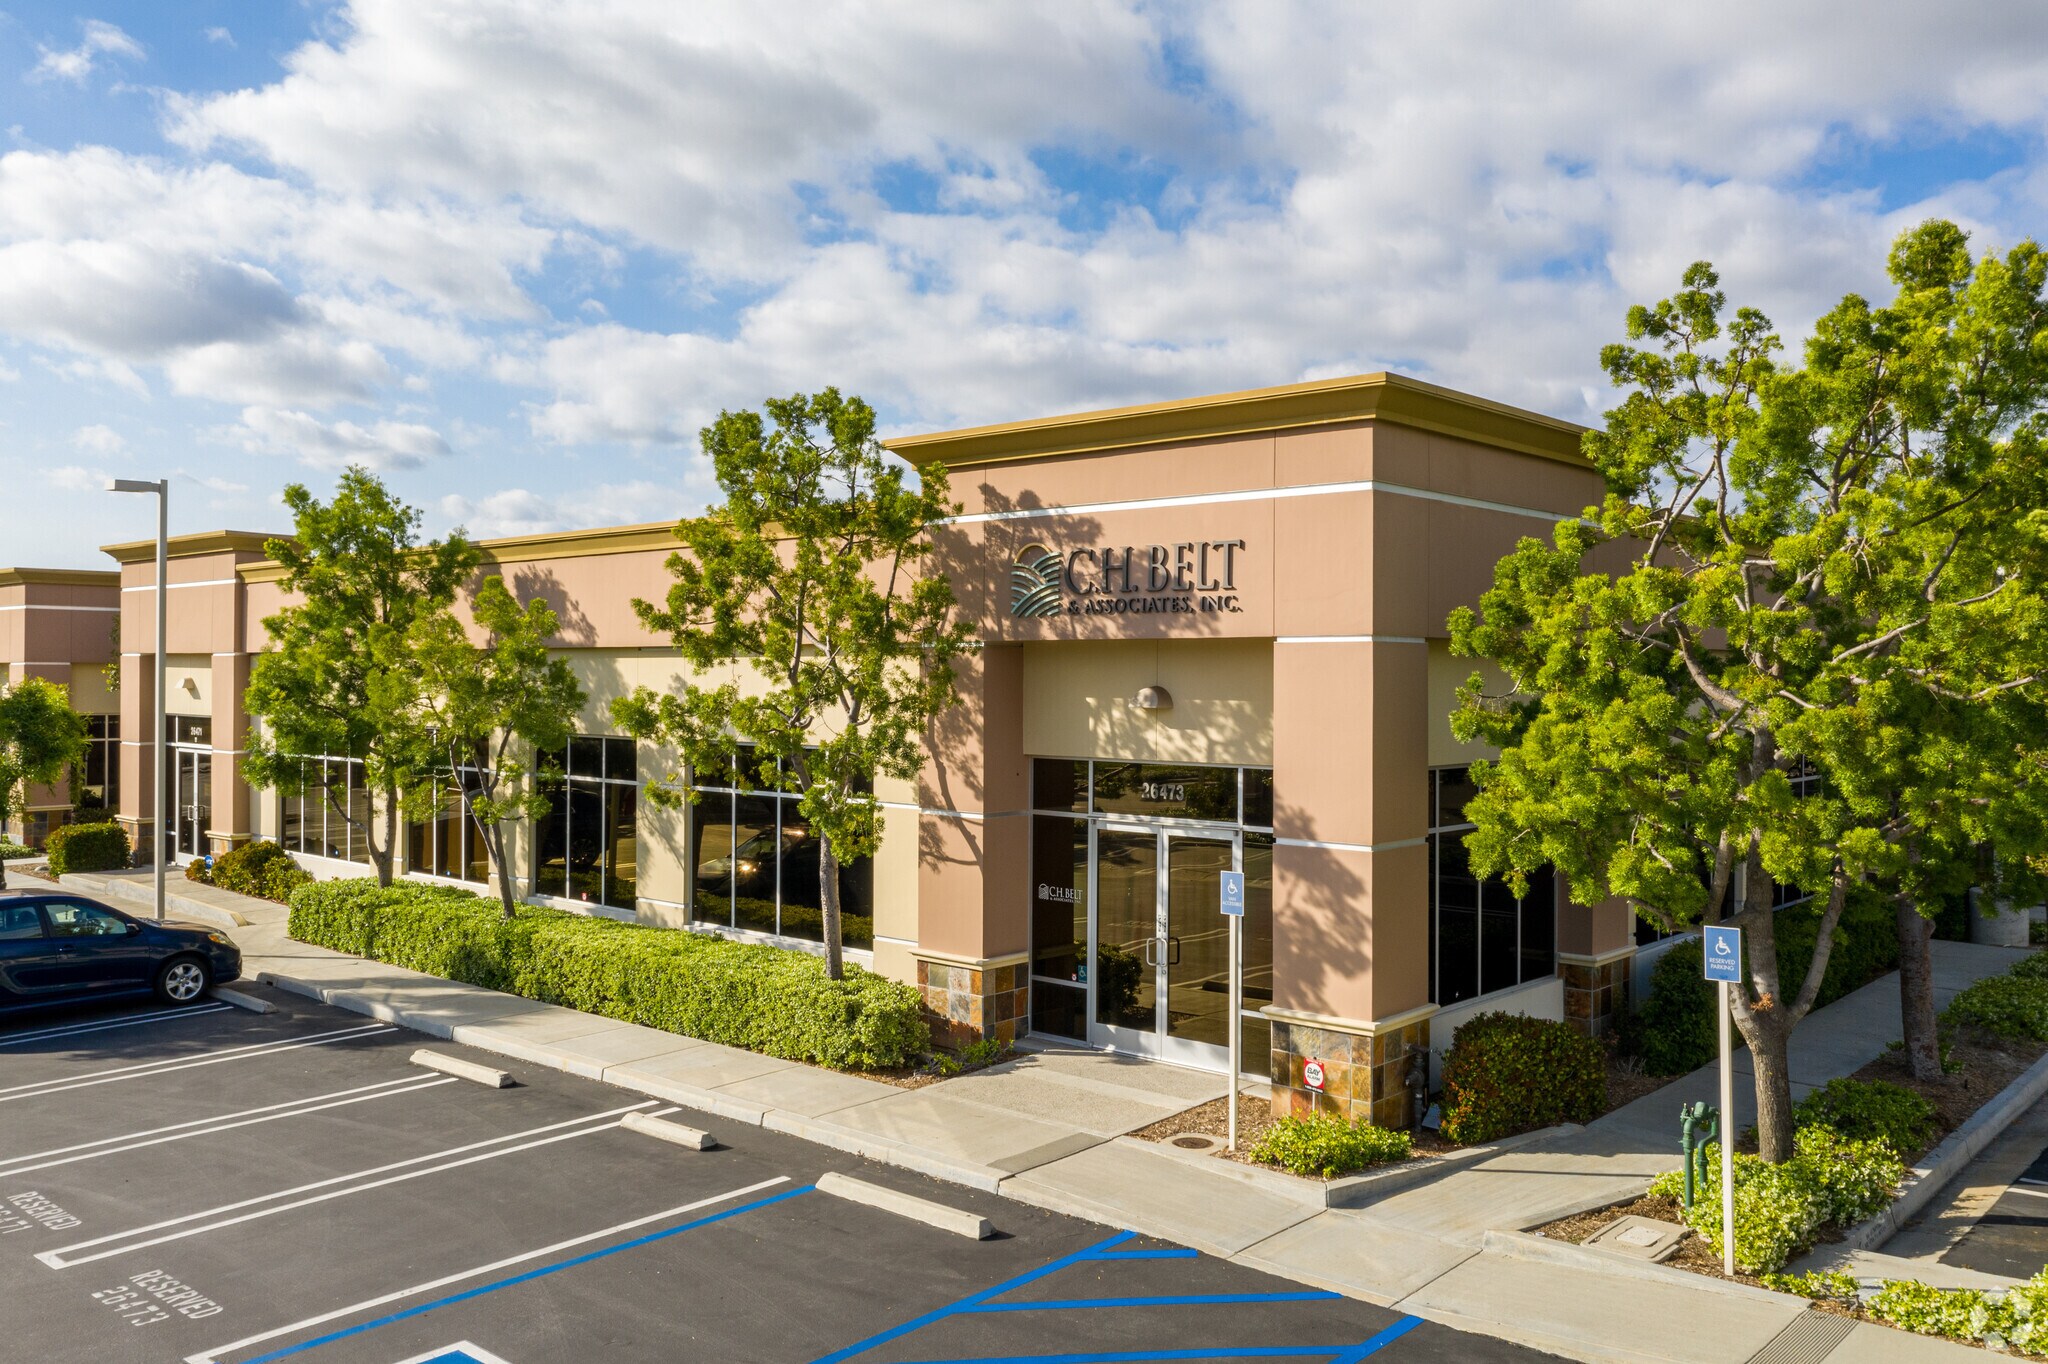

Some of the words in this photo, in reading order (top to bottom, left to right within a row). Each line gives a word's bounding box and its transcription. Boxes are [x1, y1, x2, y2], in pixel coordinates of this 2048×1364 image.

[1065, 547, 1139, 594] C.H.
[1146, 540, 1245, 592] BELT
[1068, 600, 1080, 614] &
[1085, 596, 1196, 615] ASSOCIATES,
[1199, 595, 1243, 612] INC.
[1141, 782, 1184, 801] 26473
[1065, 888, 1083, 900] BELT
[1709, 957, 1736, 965] RESERVED
[1710, 963, 1735, 971] PARKING
[1307, 1067, 1320, 1076] BAY
[7, 1191, 82, 1230] RESERVED
[129, 1269, 224, 1319] RESERVED
[91, 1286, 170, 1327] 26473
